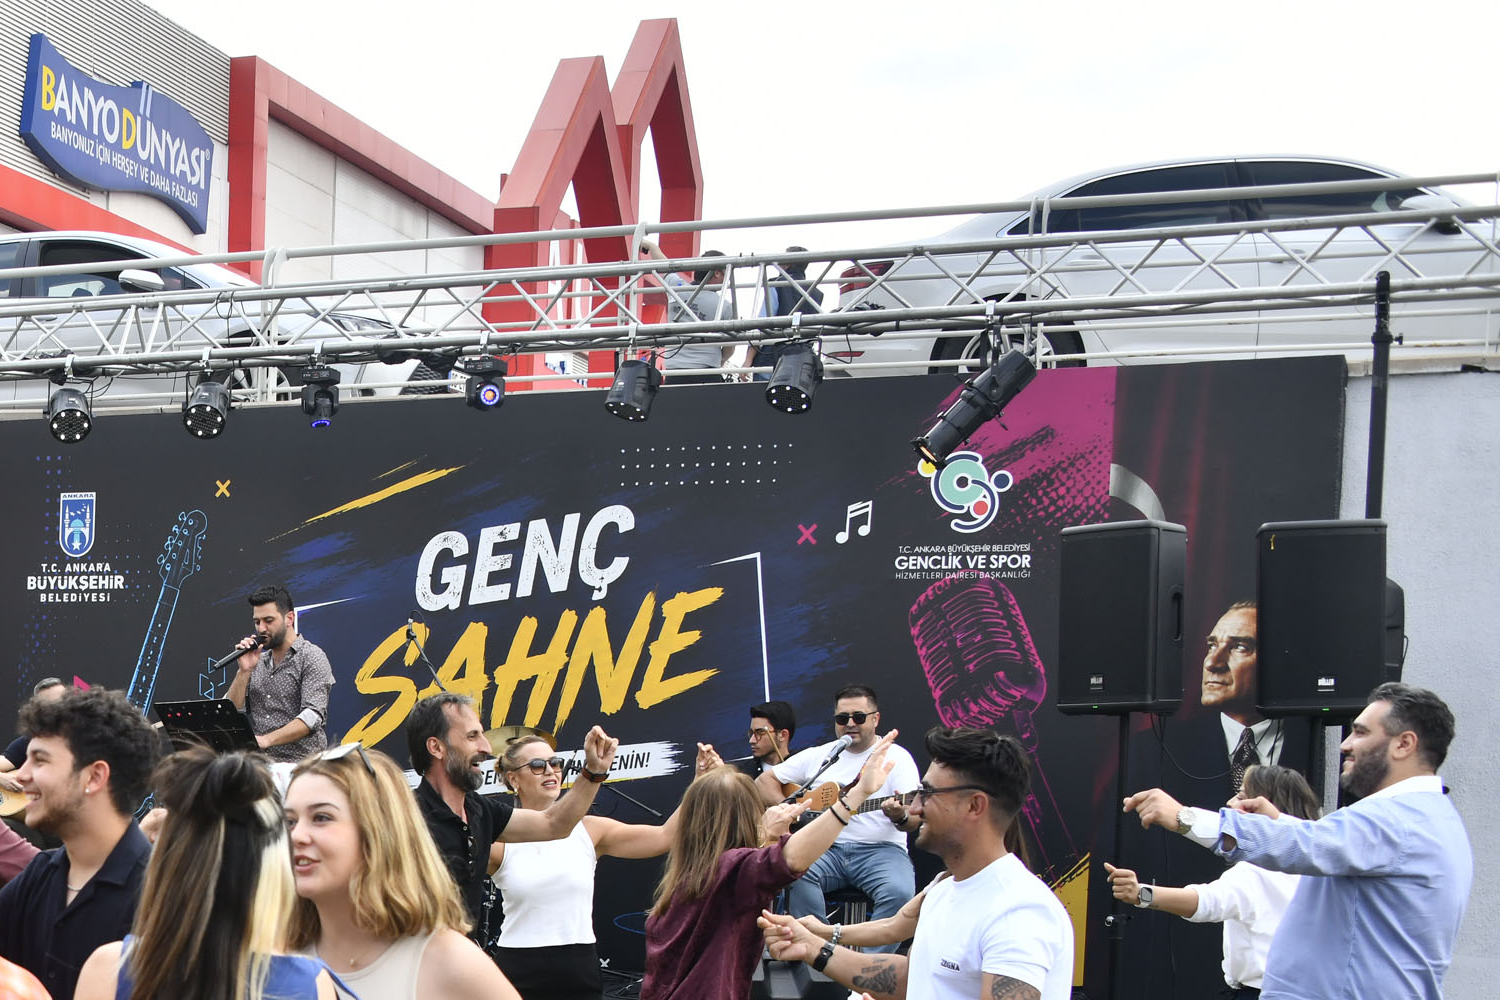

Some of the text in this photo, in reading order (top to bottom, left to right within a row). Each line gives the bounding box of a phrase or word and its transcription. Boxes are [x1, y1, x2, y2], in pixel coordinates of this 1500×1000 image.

[41, 65, 206, 190] BANYO DÜNYASI
[51, 121, 198, 208] BANYONUZ İÇİN HERŞEY VE DAHA FAZLASI
[898, 542, 1031, 554] T.C. ANKARA BÜYÜKŞEHİR BELEDİYESİ
[414, 504, 635, 612] GENÇ
[966, 555, 987, 569] VE
[989, 554, 1032, 569] SPOR
[41, 562, 112, 573] T.C. ANKARA
[895, 569, 1031, 580] HİZMETLERİ DAİRESİ BAŞKANLIĞI
[26, 574, 125, 591] BÜYÜKŞEHİR
[40, 592, 111, 603] BELEDİYESİ
[340, 582, 726, 750] SAHNE
[610, 749, 652, 772] ENİN!
